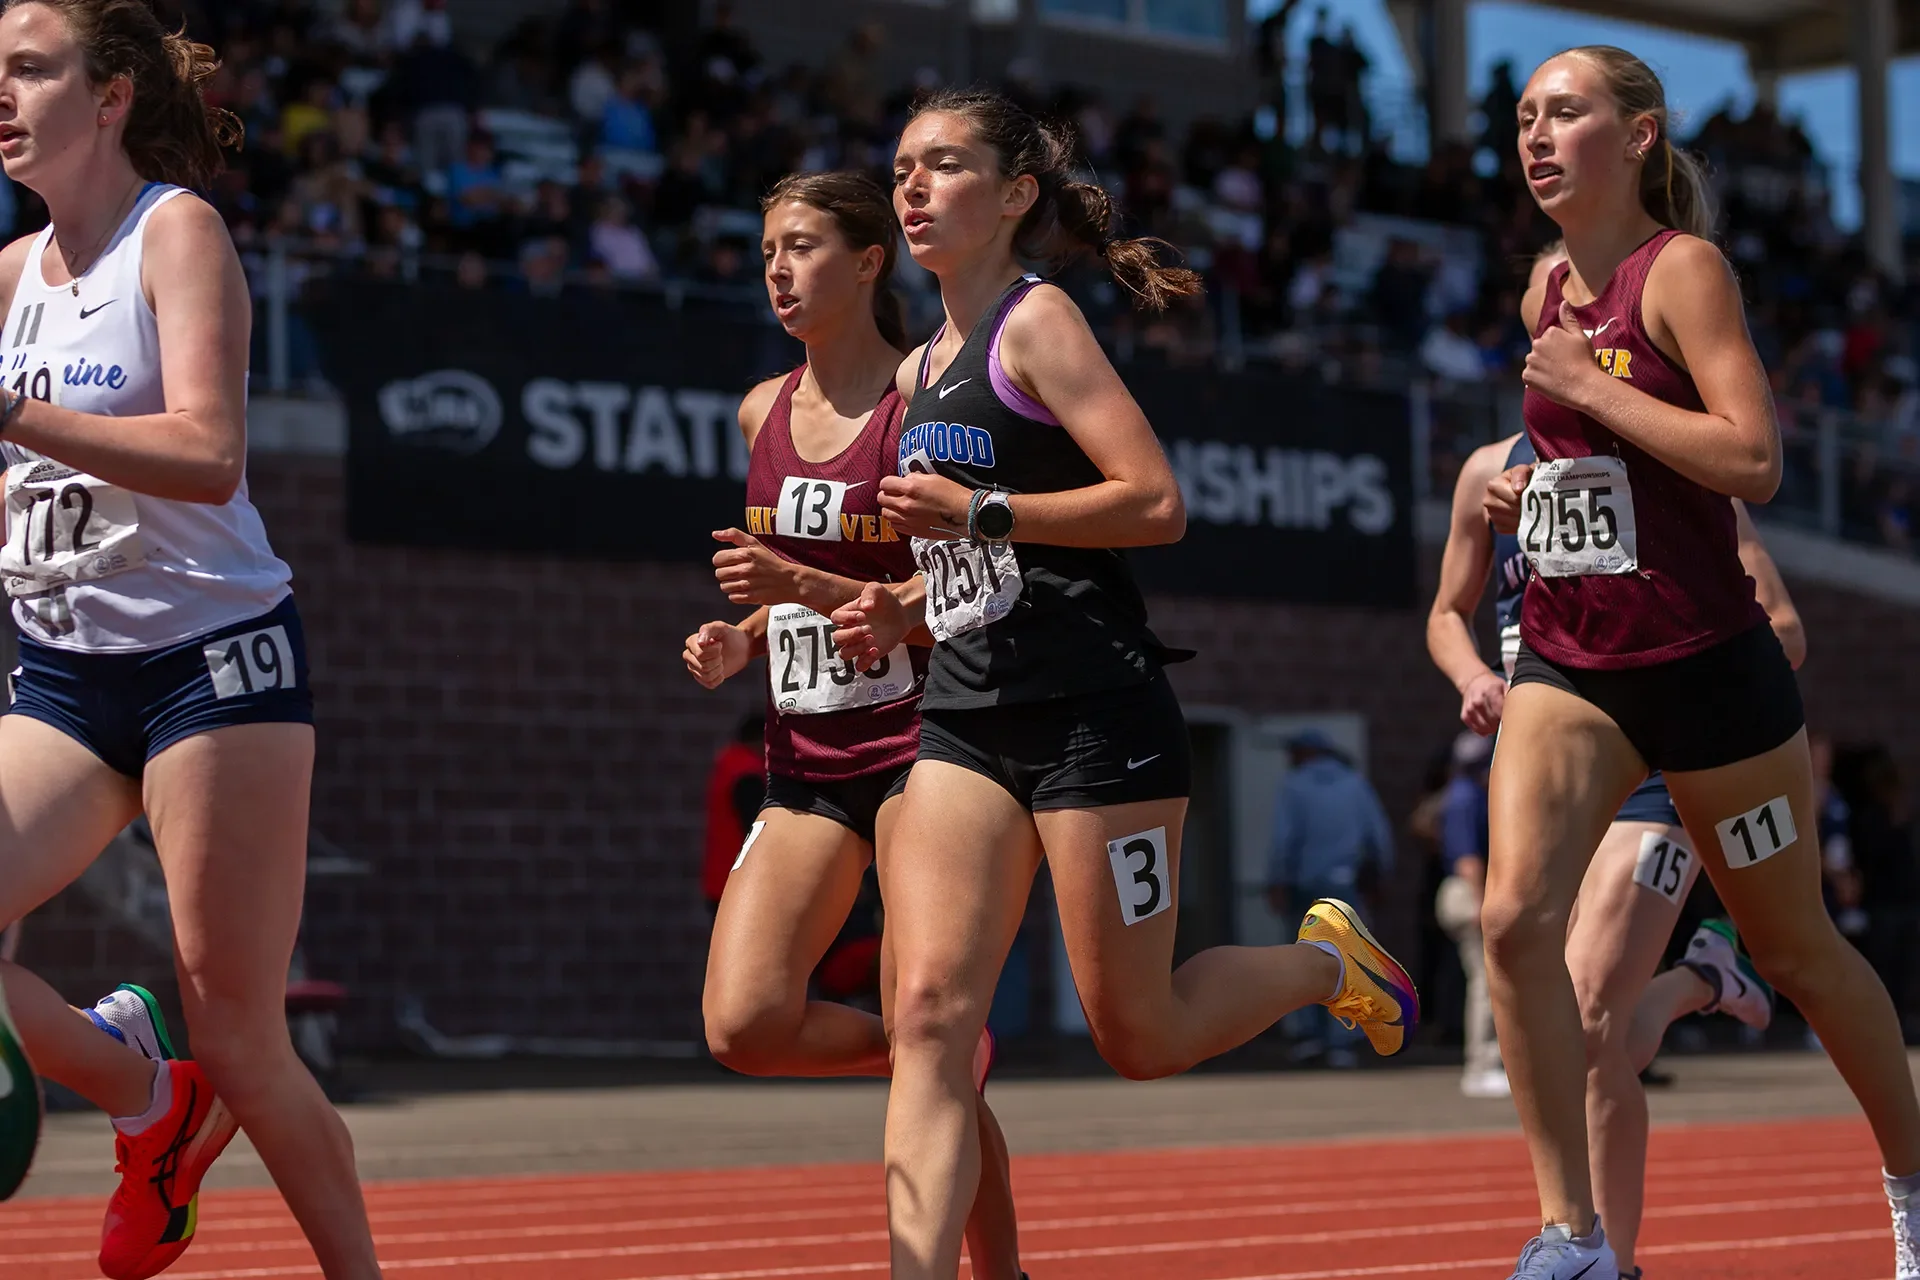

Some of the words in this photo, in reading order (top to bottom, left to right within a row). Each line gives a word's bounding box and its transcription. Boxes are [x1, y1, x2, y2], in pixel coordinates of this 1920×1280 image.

[791, 481, 832, 537] 13
[1526, 486, 1618, 553] 2755
[223, 633, 283, 692] 19
[1730, 804, 1781, 862] 11
[1123, 838, 1160, 917] 3
[1652, 841, 1688, 896] 15
